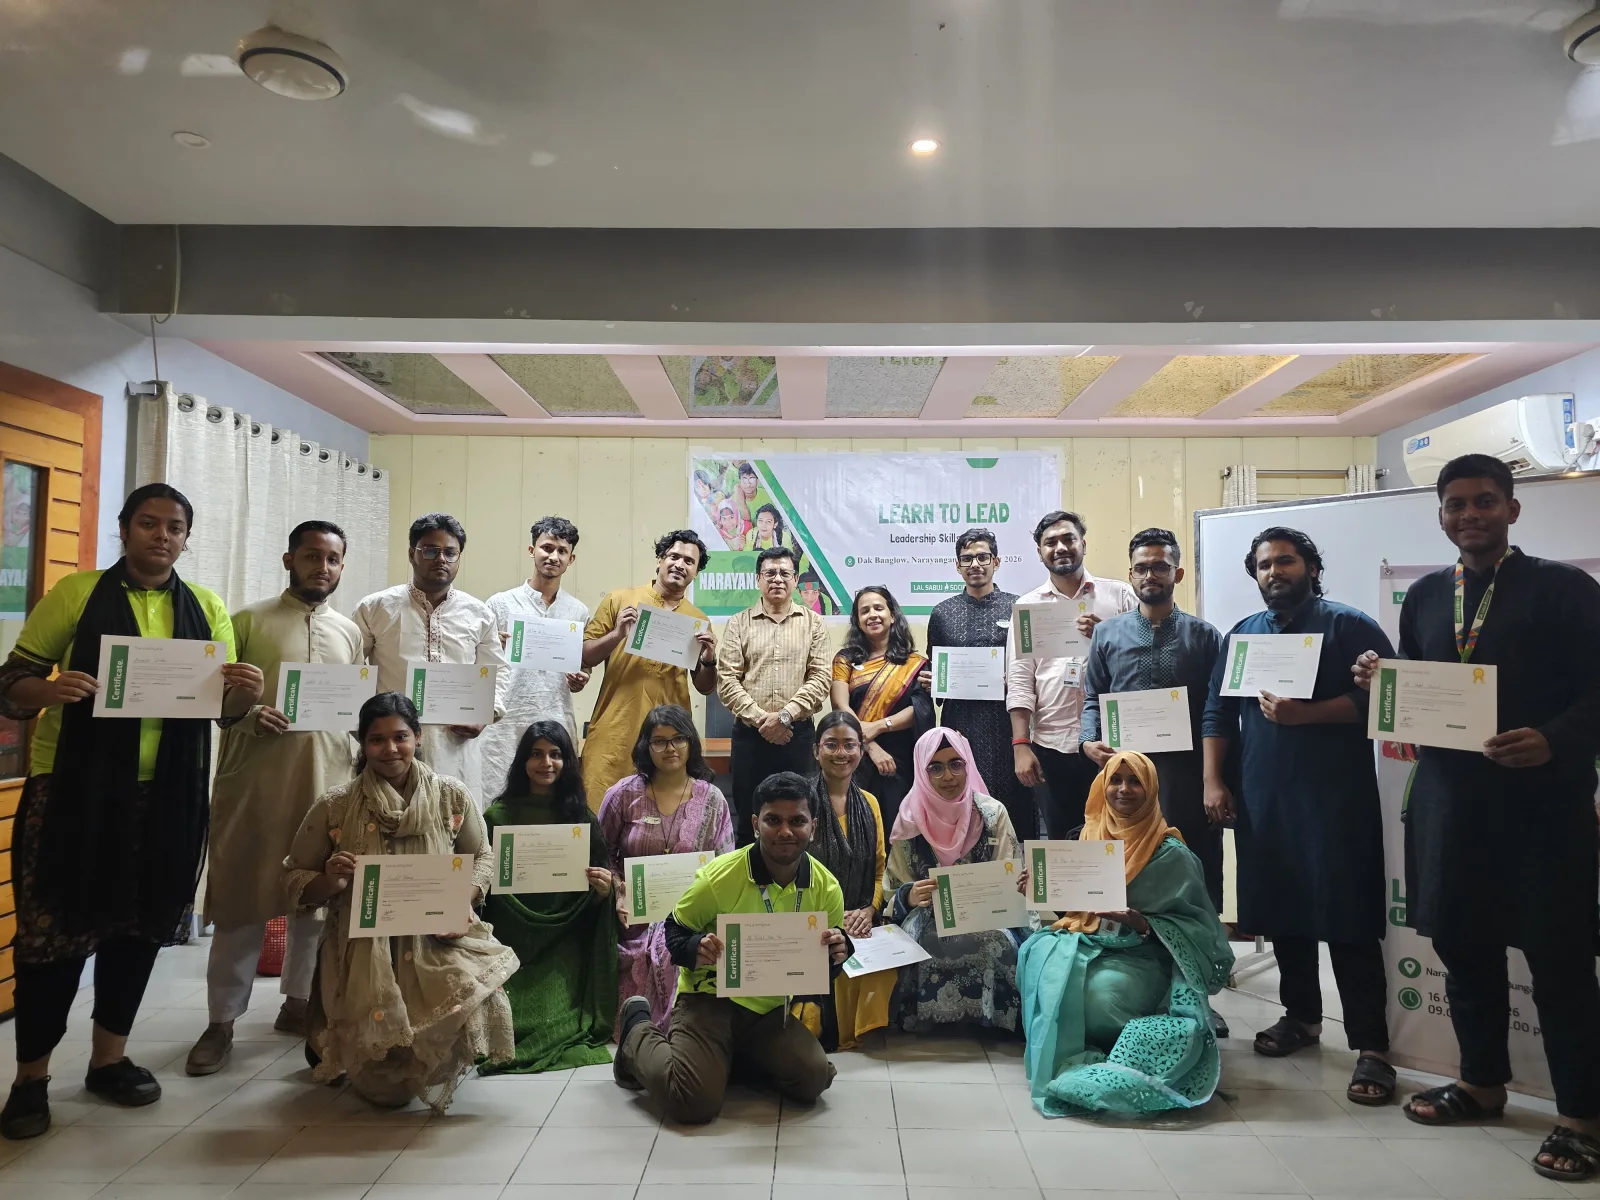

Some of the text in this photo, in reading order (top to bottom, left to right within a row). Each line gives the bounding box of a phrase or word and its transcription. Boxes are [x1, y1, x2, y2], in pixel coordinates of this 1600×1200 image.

[878, 502, 1010, 524] LEARN TO LEAD
[890, 533, 936, 545] Leadership
[857, 556, 873, 564] Dak
[874, 556, 910, 565] Banglow,
[112, 658, 124, 700] Certificate.
[1233, 651, 1245, 684] Certificate.
[287, 682, 297, 717] Certificate.
[1383, 682, 1393, 723] Certificate.
[503, 845, 511, 880] Certificate.
[364, 878, 375, 920] Certificate.
[1428, 992, 1440, 1002] 16
